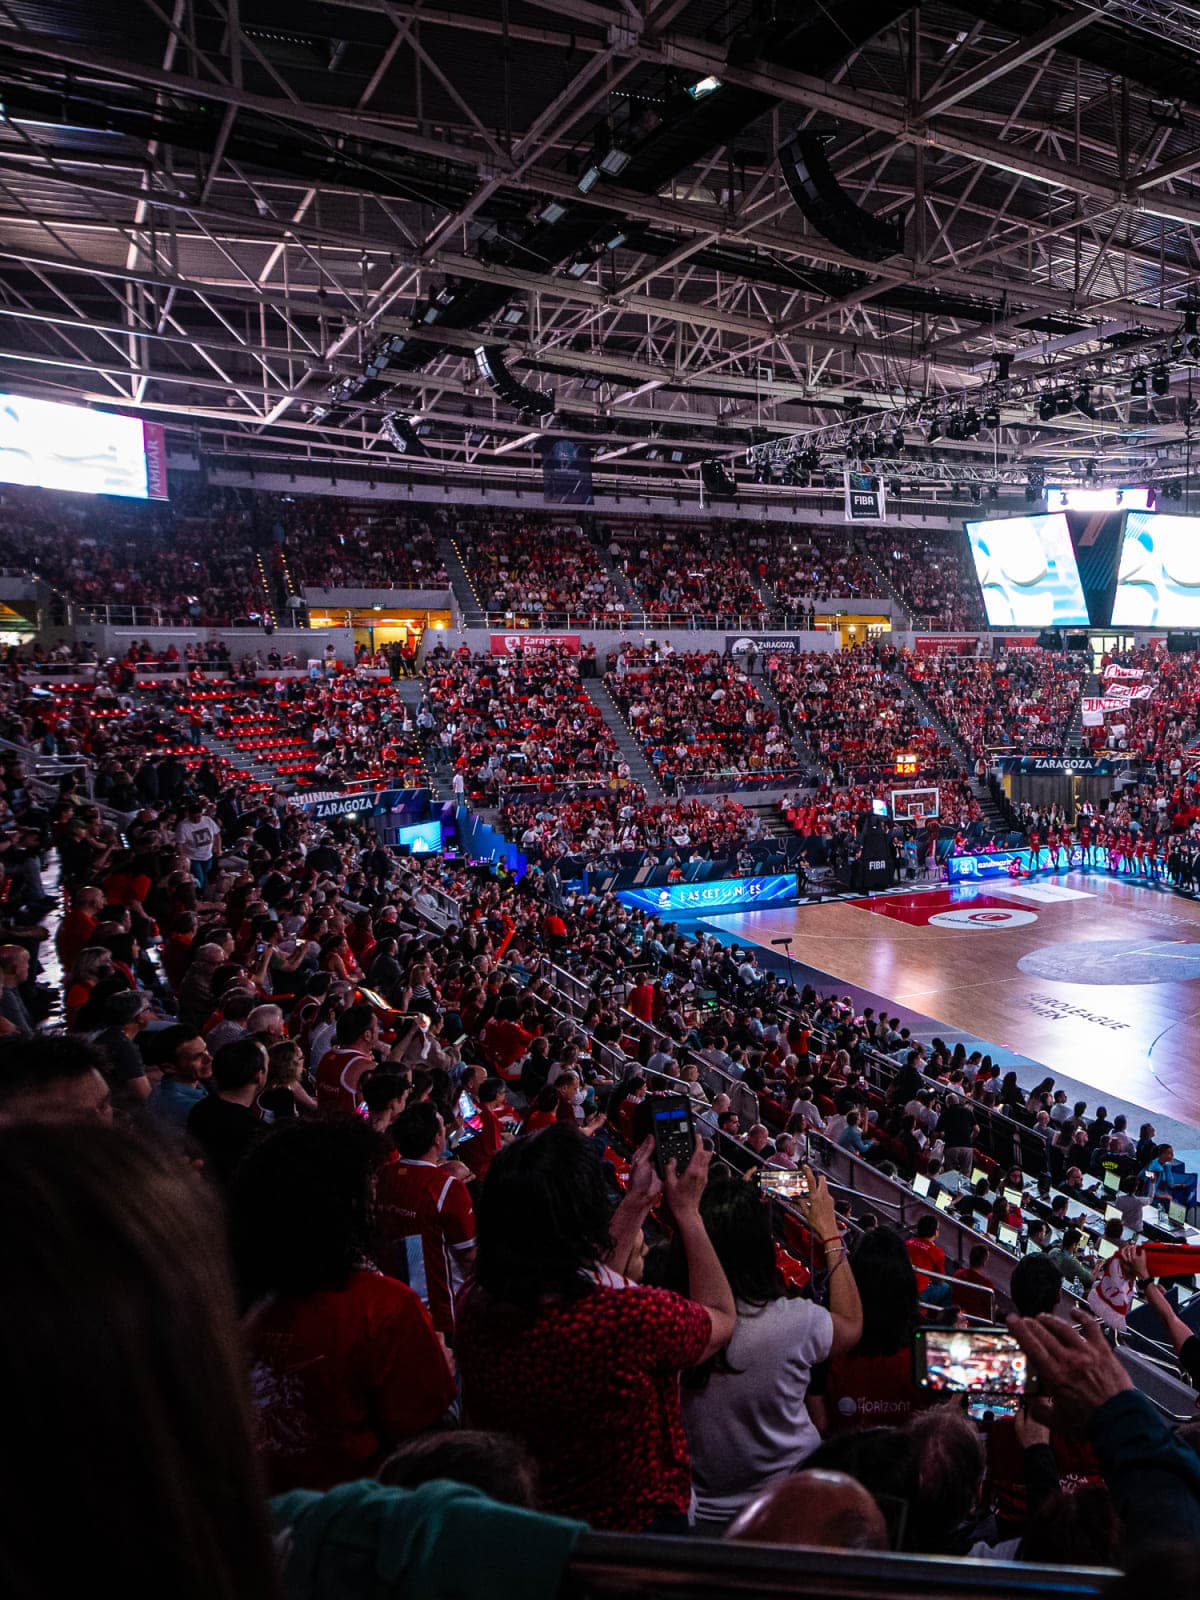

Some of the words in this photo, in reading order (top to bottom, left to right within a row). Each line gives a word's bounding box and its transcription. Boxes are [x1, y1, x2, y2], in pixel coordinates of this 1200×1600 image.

[854, 496, 874, 506] FIBA
[1035, 759, 1092, 769] ZARAGOZA
[316, 798, 373, 817] ZARAGOZA
[869, 860, 886, 870] FIBA
